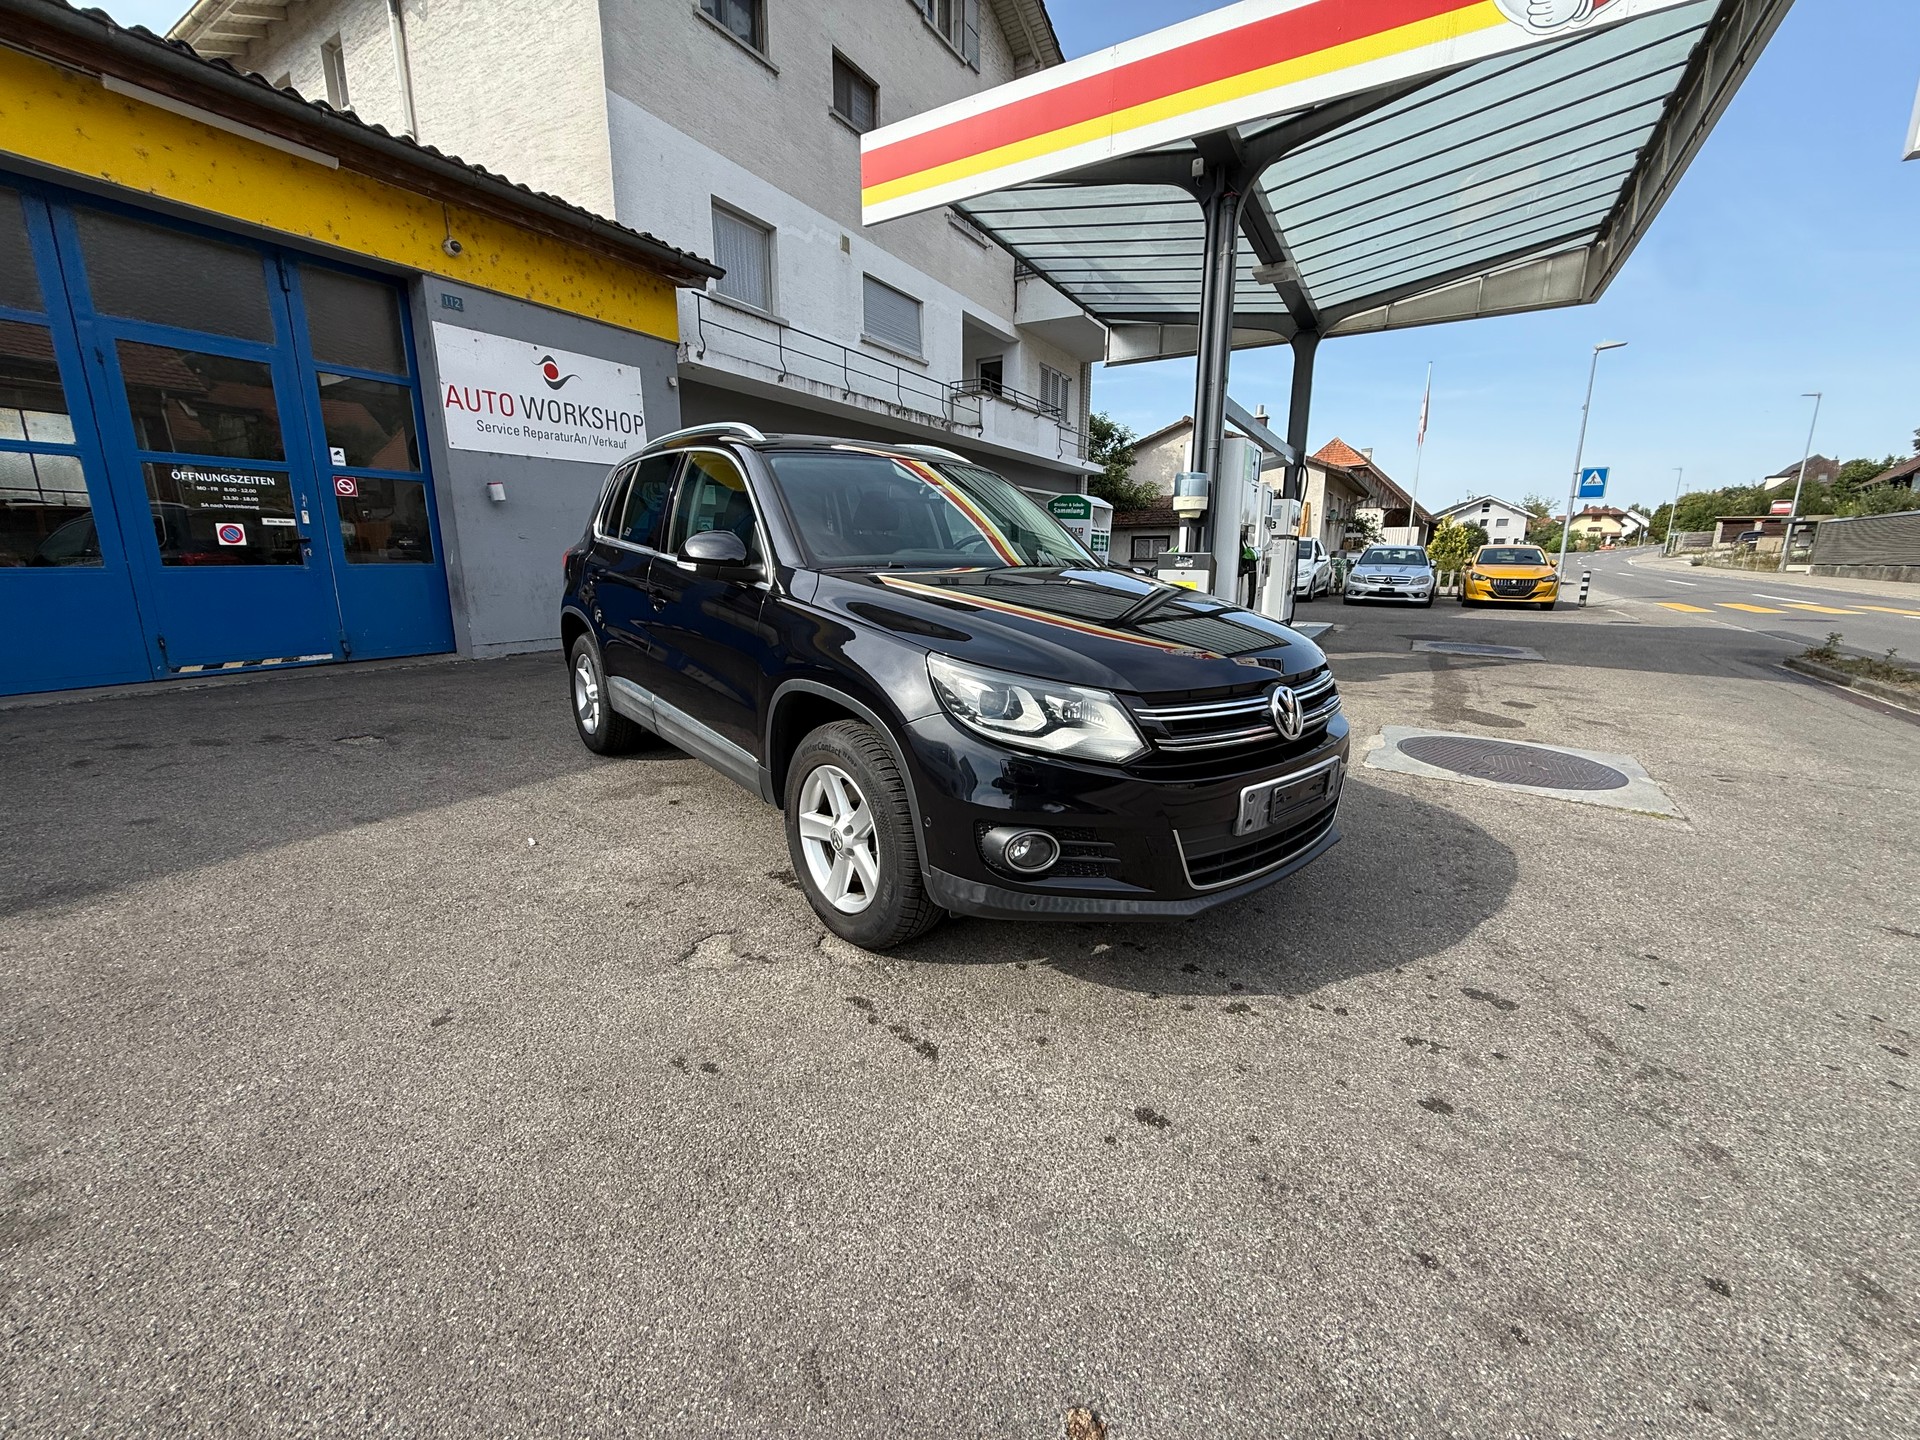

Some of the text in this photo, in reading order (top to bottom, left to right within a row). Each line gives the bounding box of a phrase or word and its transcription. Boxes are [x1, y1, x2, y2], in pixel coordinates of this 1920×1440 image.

[444, 295, 461, 308] 112
[445, 384, 644, 435] AUTO WORKSHOP
[476, 419, 520, 437] Service
[171, 469, 276, 486] ÖFFNUNGSZEITEN
[1053, 507, 1085, 516] Sammlung
[801, 741, 841, 758] WinterContact
